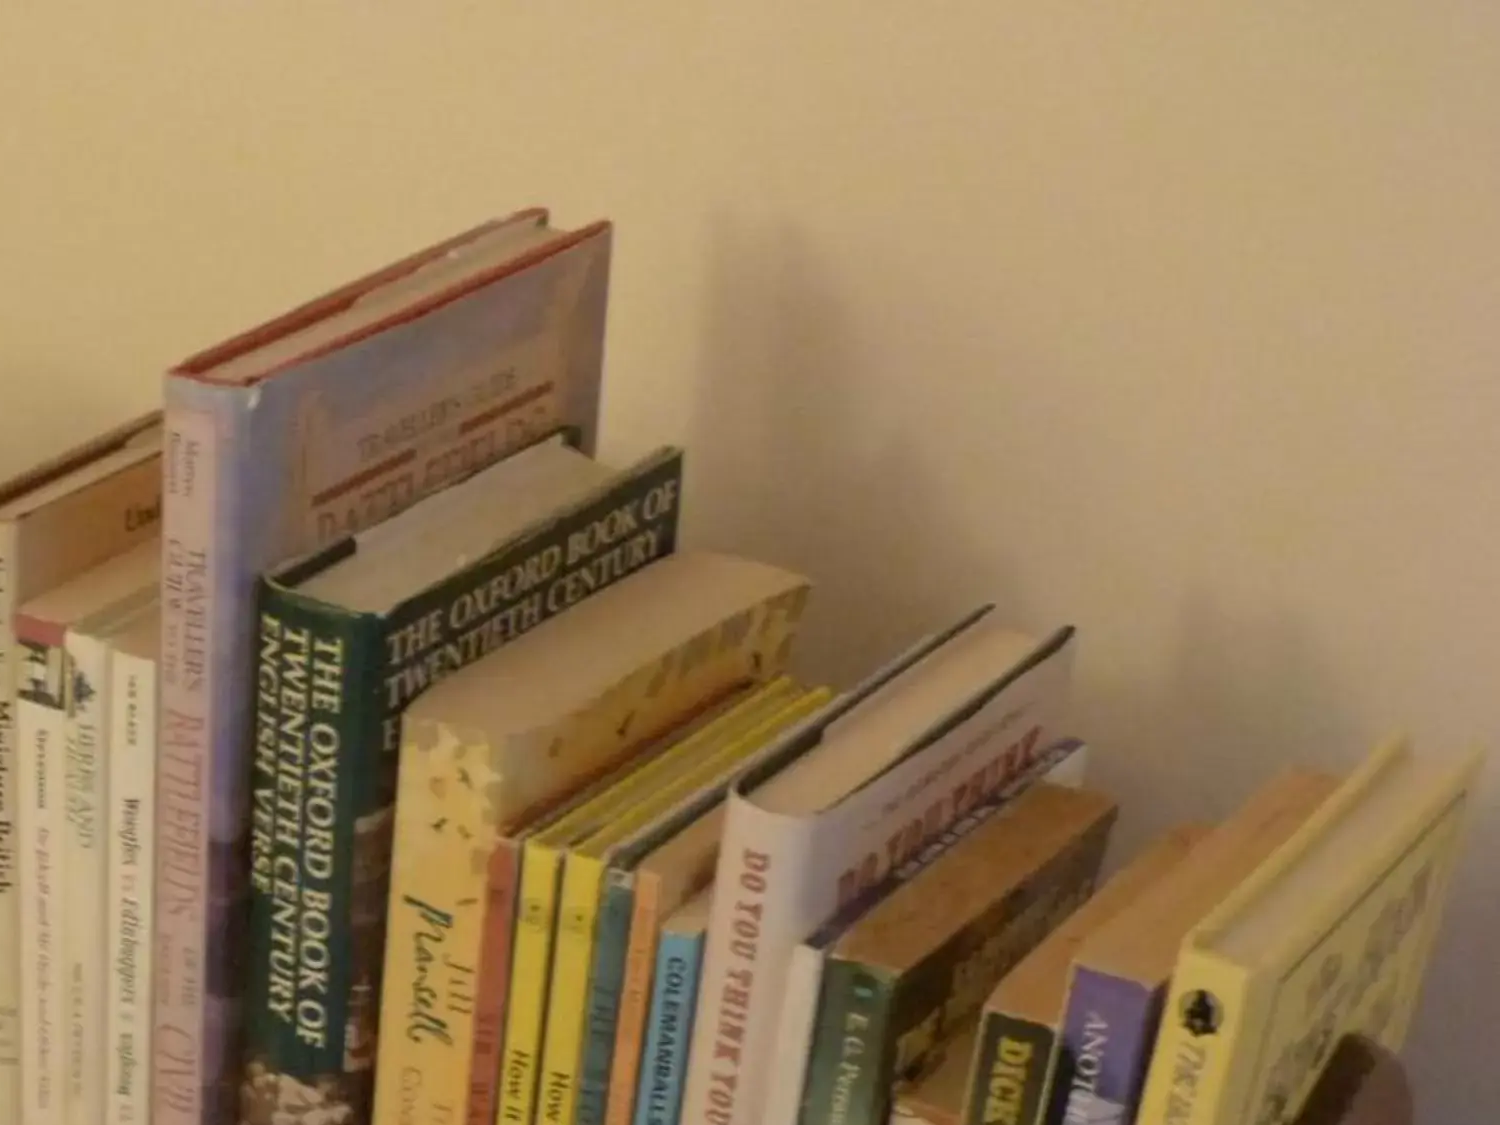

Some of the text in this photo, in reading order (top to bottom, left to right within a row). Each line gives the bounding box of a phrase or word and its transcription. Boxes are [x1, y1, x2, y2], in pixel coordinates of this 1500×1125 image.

[386, 479, 677, 665] THE OXFORD BOOK OF
[384, 526, 662, 709] TWENTIETH CENTURY
[250, 611, 282, 895] ENGLISH VERSE
[77, 796, 97, 851] AND
[119, 798, 142, 868] Weegies
[266, 627, 312, 1025] TWENTIETH CENTURY
[295, 637, 345, 1050] THE OXFORD BOOK OF
[740, 846, 770, 894] DO
[402, 893, 454, 1048] Mansell
[729, 899, 764, 962] YOU
[443, 952, 476, 1015] Jill
[713, 968, 754, 1067] THINK
[154, 1023, 196, 1113] CIVIL
[505, 1048, 531, 1098] How
[547, 1071, 570, 1119] How
[503, 1104, 519, 1123] it
